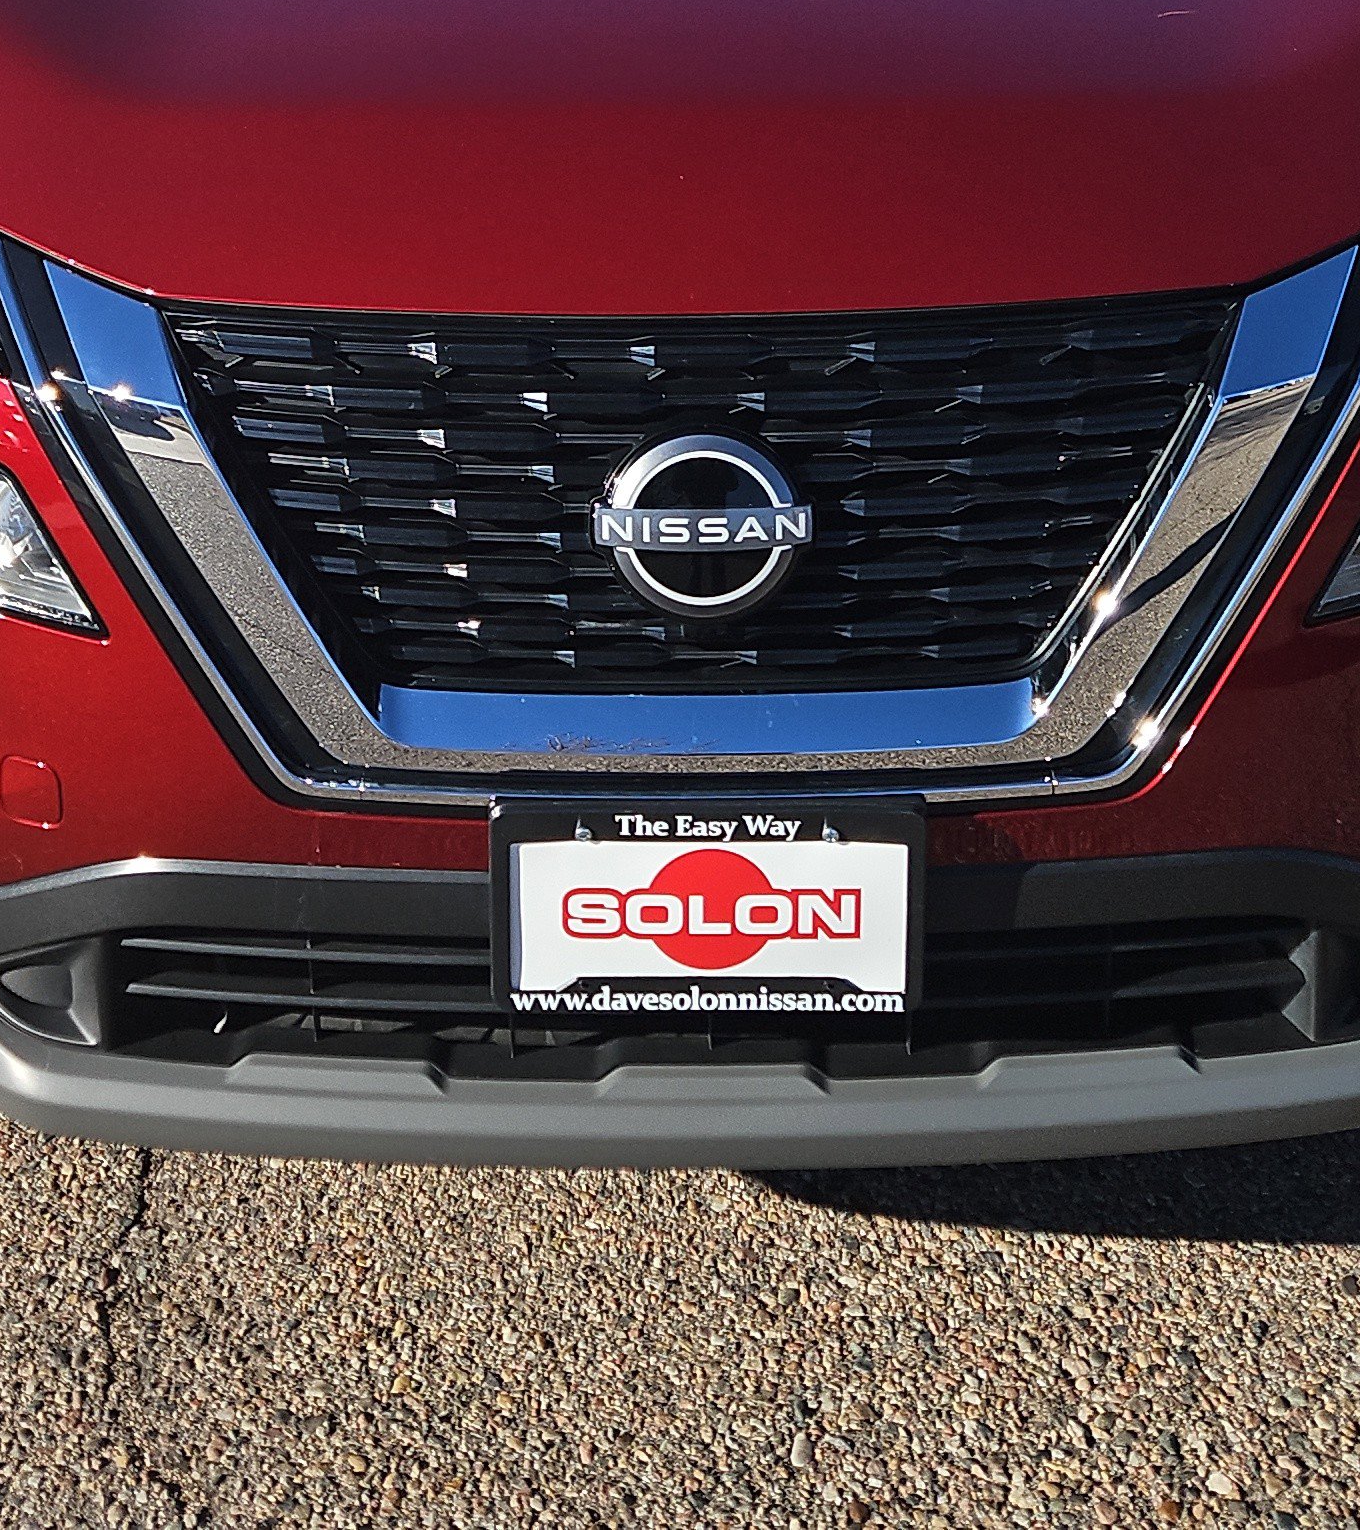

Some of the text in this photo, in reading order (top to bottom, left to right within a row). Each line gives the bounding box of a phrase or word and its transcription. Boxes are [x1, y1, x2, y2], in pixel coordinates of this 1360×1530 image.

[600, 512, 807, 544] NISSAN
[614, 814, 802, 842] The Easy Way
[563, 889, 861, 939] SOLON
[510, 985, 906, 1013] www.davesolonnissan.com
